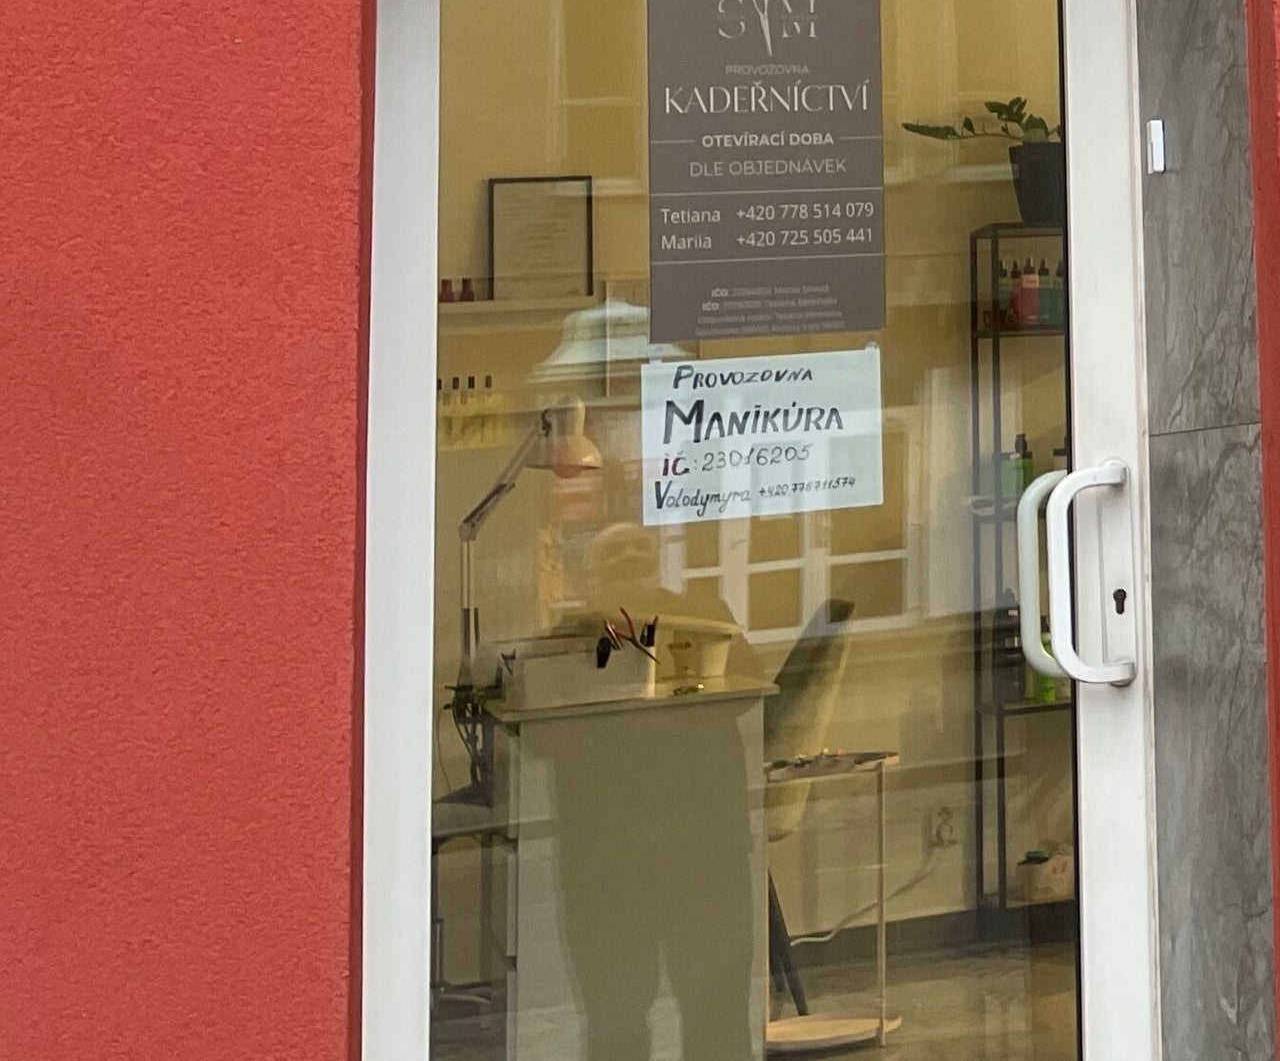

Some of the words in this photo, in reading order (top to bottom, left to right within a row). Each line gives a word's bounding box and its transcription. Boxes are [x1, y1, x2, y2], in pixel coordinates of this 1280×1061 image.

[725, 64, 810, 76] PROVOZOVNA
[702, 131, 786, 147] OTEVÍRACÍ
[789, 132, 834, 146] DOBA
[690, 161, 723, 177] DLE
[729, 155, 847, 175] OBJEDNÁVEK
[661, 208, 721, 224] Tetiana
[736, 205, 775, 221] +420
[780, 204, 808, 219] 778
[813, 203, 841, 219] 514
[845, 202, 874, 218] 079
[661, 234, 712, 250] Mariia
[736, 231, 775, 247] +420
[780, 230, 808, 245] 725
[813, 228, 841, 244] 505
[845, 227, 873, 243] 441
[673, 365, 813, 389] PROVOZOVNA
